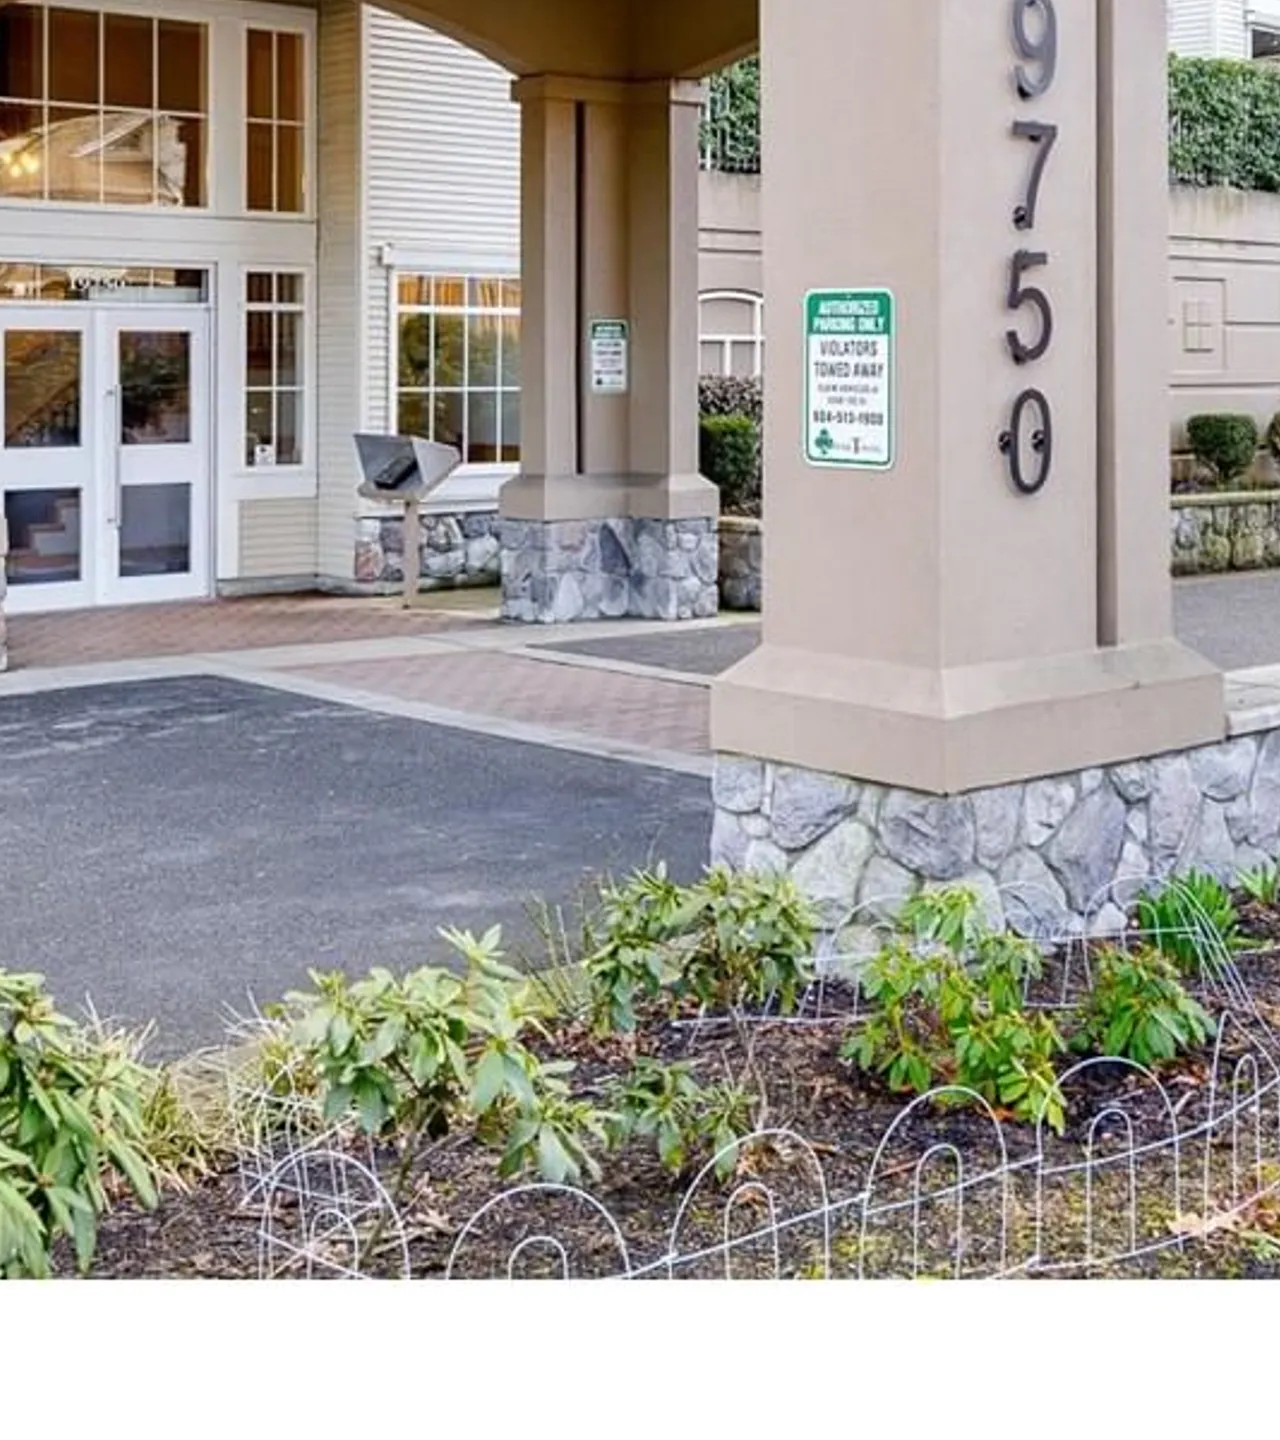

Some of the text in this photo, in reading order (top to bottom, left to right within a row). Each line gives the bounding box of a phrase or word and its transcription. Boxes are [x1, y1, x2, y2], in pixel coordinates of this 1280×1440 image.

[820, 340, 878, 357] VIOLATORS
[813, 361, 884, 378] TOWED AWAY
